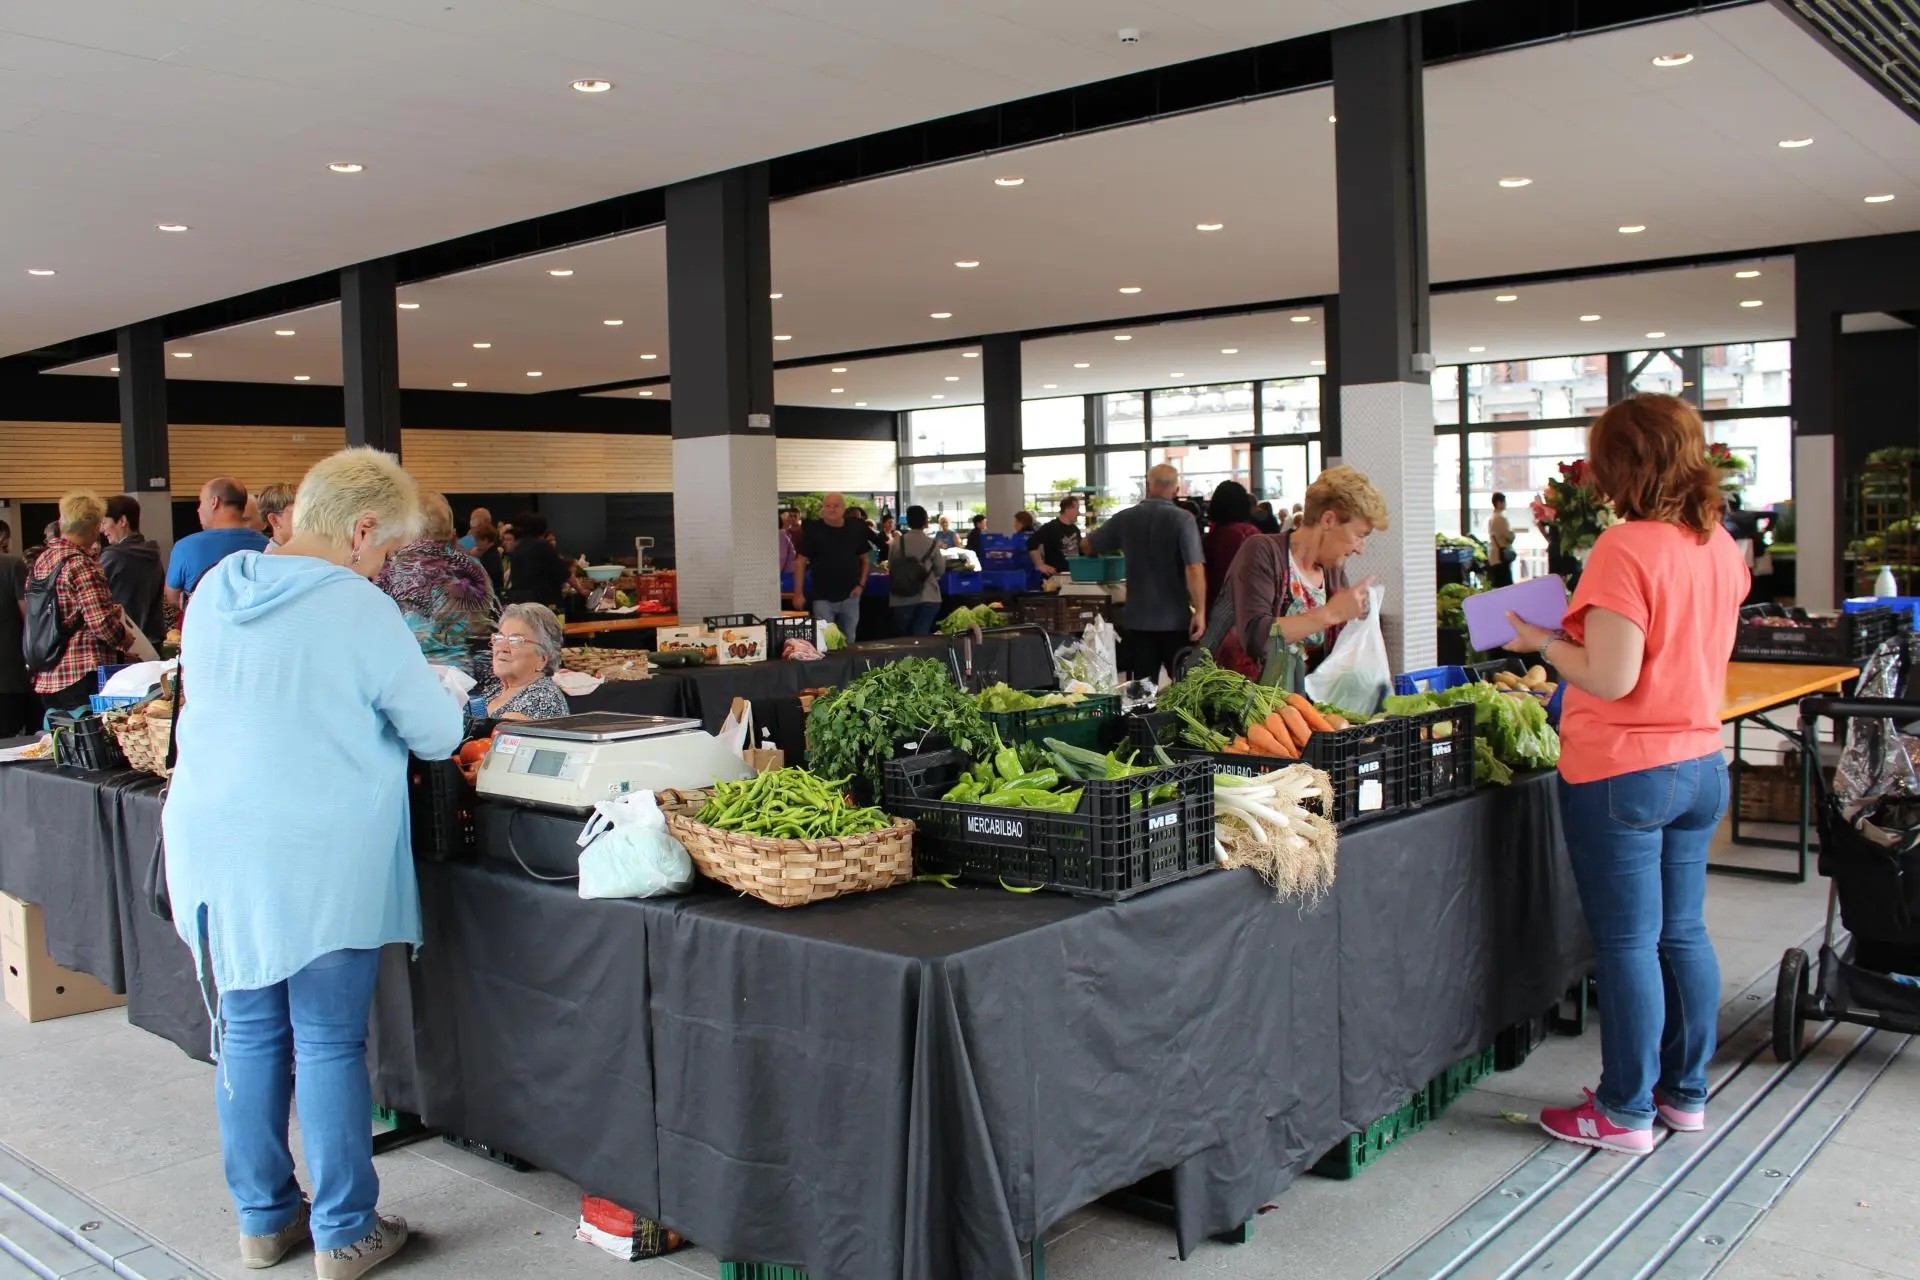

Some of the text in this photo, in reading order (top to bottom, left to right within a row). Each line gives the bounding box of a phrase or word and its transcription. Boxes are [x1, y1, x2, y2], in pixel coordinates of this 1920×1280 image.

[1213, 763, 1252, 778] RCABILBAO
[1358, 760, 1380, 775] MB
[967, 816, 1023, 838] MERCABILBAO
[1148, 813, 1178, 830] MB
[1577, 1118, 1599, 1138] N
